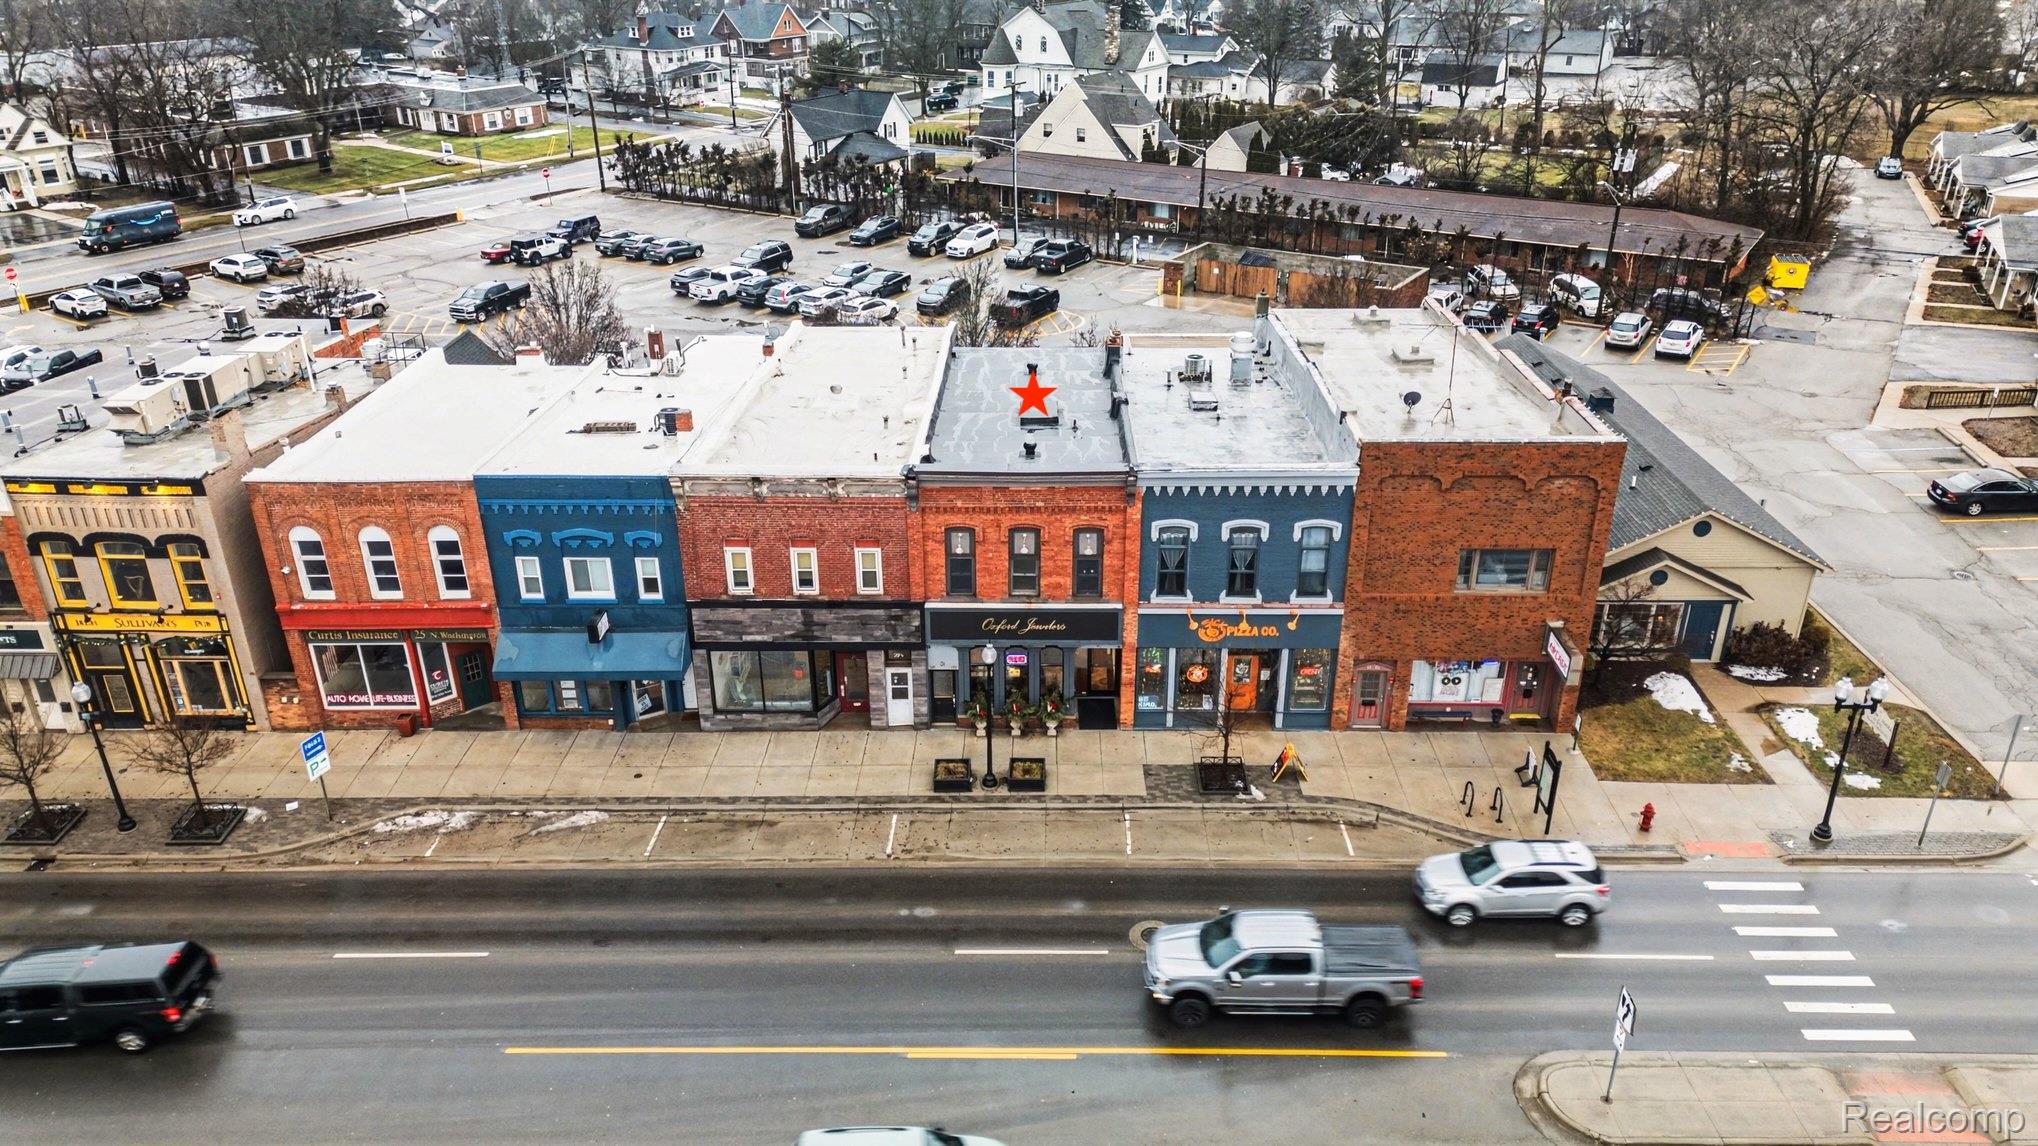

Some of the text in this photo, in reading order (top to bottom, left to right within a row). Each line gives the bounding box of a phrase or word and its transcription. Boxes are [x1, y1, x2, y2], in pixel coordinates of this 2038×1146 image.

[982, 617, 1066, 635] Oxford Jewelers
[1226, 625, 1279, 637] PIZZA CO.
[308, 631, 399, 640] Curtis Insurance
[414, 629, 426, 639] 25
[440, 632, 487, 640] Washington
[327, 694, 347, 703] AUTO
[310, 761, 319, 777] P
